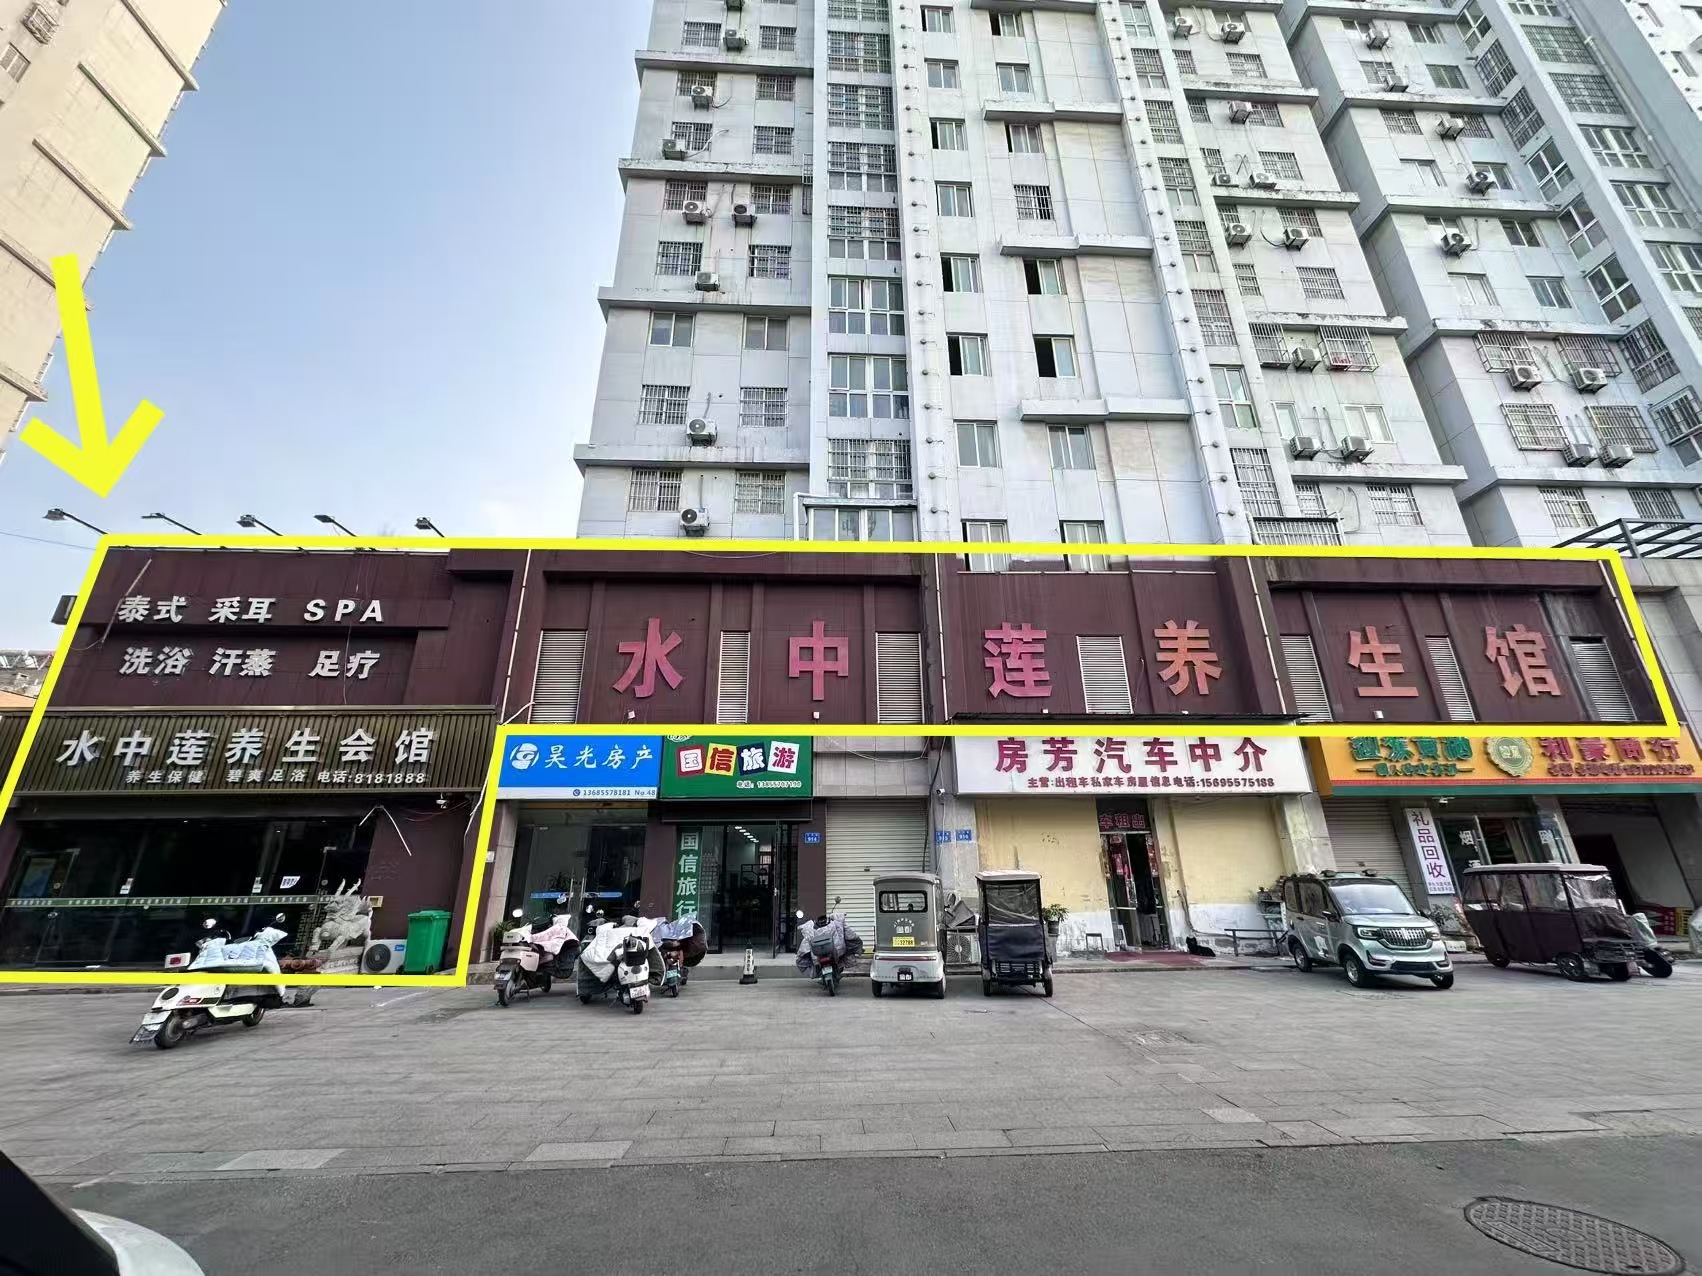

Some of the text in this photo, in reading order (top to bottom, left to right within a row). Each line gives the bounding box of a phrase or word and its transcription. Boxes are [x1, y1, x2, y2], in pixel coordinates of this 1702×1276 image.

[118, 595, 384, 623] 泰式 采耳 SPA
[119, 647, 380, 680] 洗浴 汗蒸 足疗
[613, 617, 1562, 701] 水中莲养生馆
[56, 727, 434, 767] 水中莲养生会馆
[545, 744, 653, 769] 昊光房产
[679, 745, 796, 773] 国信旅游
[995, 736, 1268, 774] 房芳汽车中介
[126, 769, 204, 784] 养生保健
[1411, 810, 1447, 879] 礼品回收
[675, 832, 700, 922] 国信旅行
